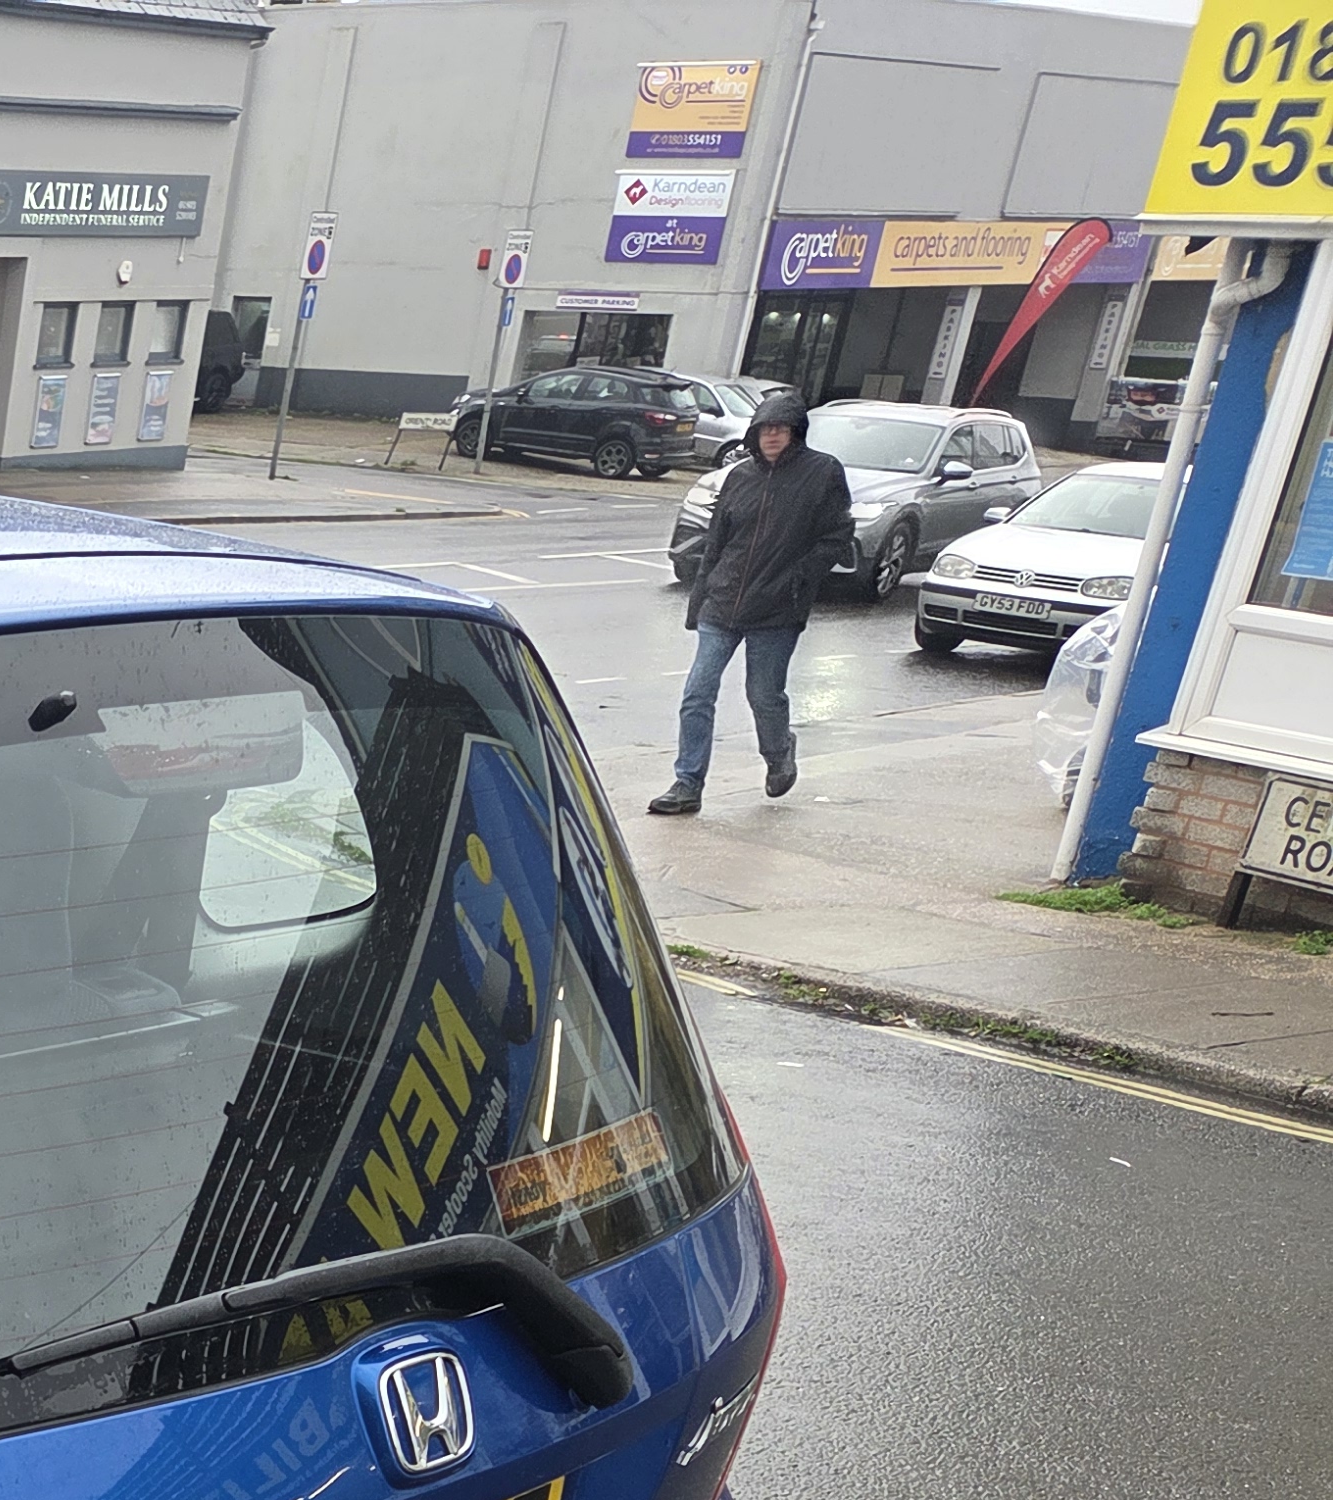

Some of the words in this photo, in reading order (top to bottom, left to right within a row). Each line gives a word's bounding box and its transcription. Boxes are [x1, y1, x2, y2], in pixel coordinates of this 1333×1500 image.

[23, 182, 93, 211] KATIE
[98, 184, 170, 212] MILLS
[652, 178, 726, 194] Karndean
[20, 213, 87, 226] INDEPENDENT
[88, 214, 127, 226] FUNERAL
[128, 215, 165, 226] SERVICE
[666, 218, 678, 227] at
[893, 231, 948, 266] carpets
[949, 228, 979, 258] and
[976, 227, 1032, 265] flooring
[560, 298, 599, 306] CUSTOMER
[602, 298, 636, 306] PARKING
[937, 308, 958, 368] PARKING
[1098, 304, 1118, 359] PARKING
[979, 594, 1015, 611] GY53
[1016, 600, 1046, 615] FDD
[1279, 834, 1333, 876] RO
